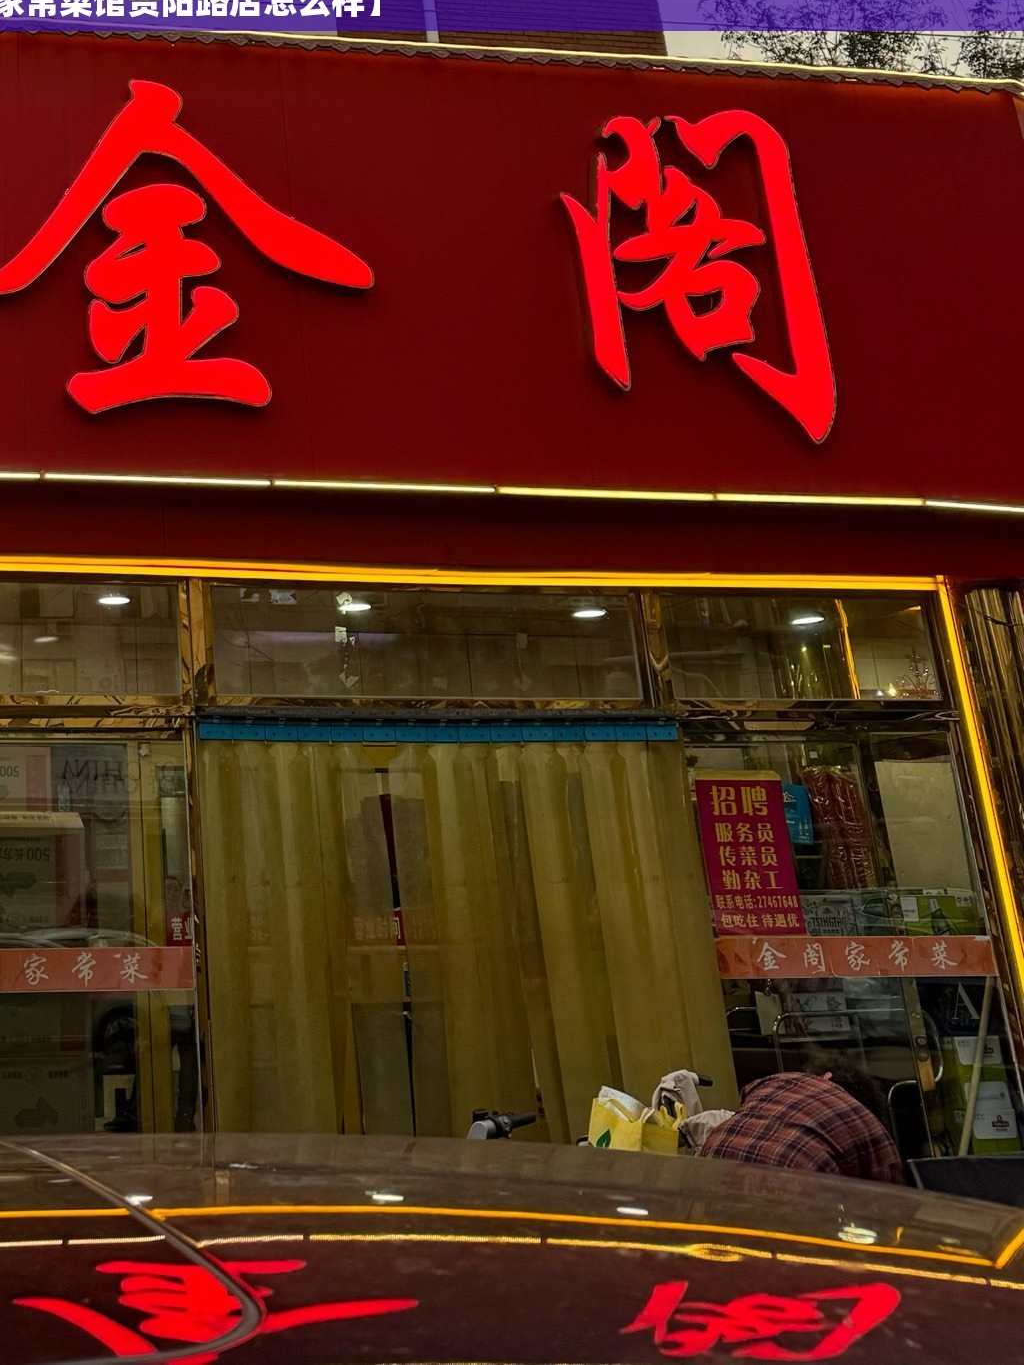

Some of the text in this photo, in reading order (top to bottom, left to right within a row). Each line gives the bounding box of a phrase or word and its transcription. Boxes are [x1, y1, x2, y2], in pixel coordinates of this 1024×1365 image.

[709, 785, 769, 816] 招聘
[714, 822, 775, 843] 服务员
[718, 845, 778, 867] 传菜员
[721, 869, 783, 891] 勤杂工
[720, 913, 800, 928] 包吃住 待遇优
[756, 938, 958, 975] 金阁家常菜
